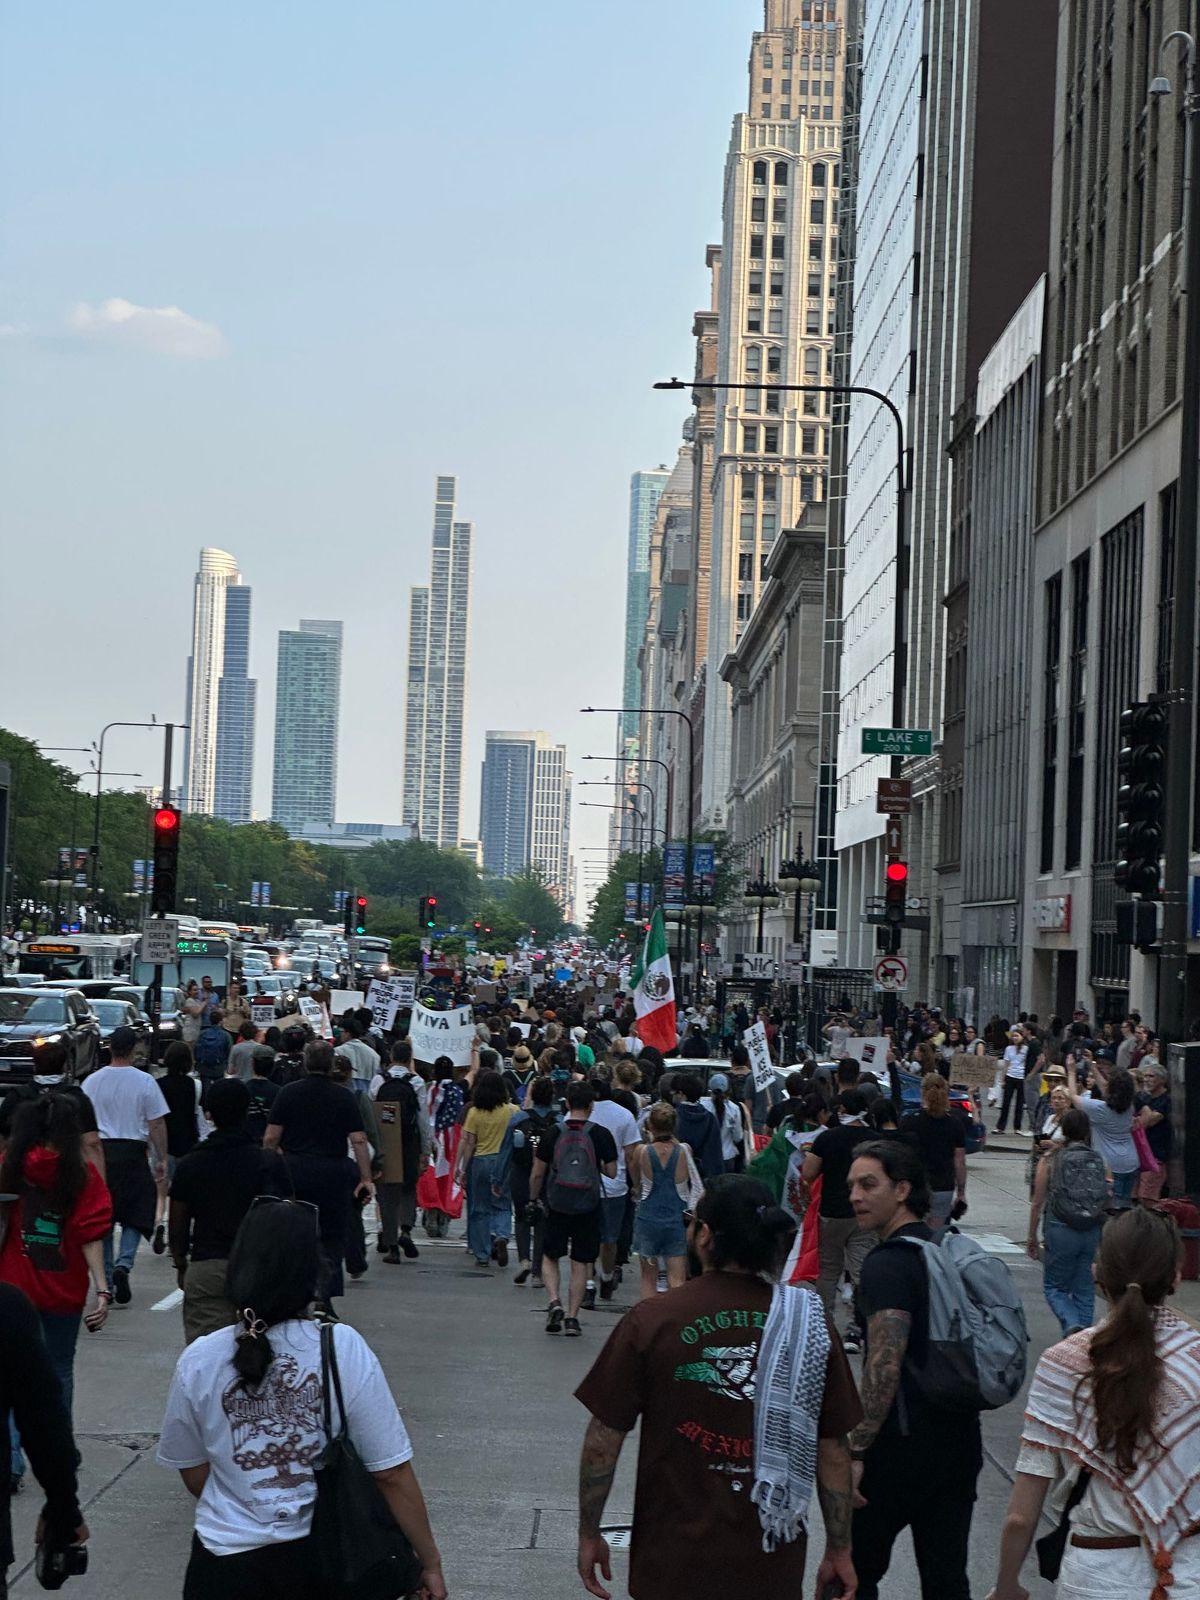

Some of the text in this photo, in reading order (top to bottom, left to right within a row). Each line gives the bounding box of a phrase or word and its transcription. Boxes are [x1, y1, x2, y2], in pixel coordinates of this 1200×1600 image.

[877, 732, 914, 743] LAKE
[918, 734, 929, 742] ST
[371, 987, 400, 1001] PEOPLE
[380, 982, 395, 993] THE
[374, 1016, 389, 1027] UT
[416, 1009, 450, 1030] VIVA
[681, 1309, 769, 1344] ORGUL
[676, 1421, 753, 1458] MEXIC
